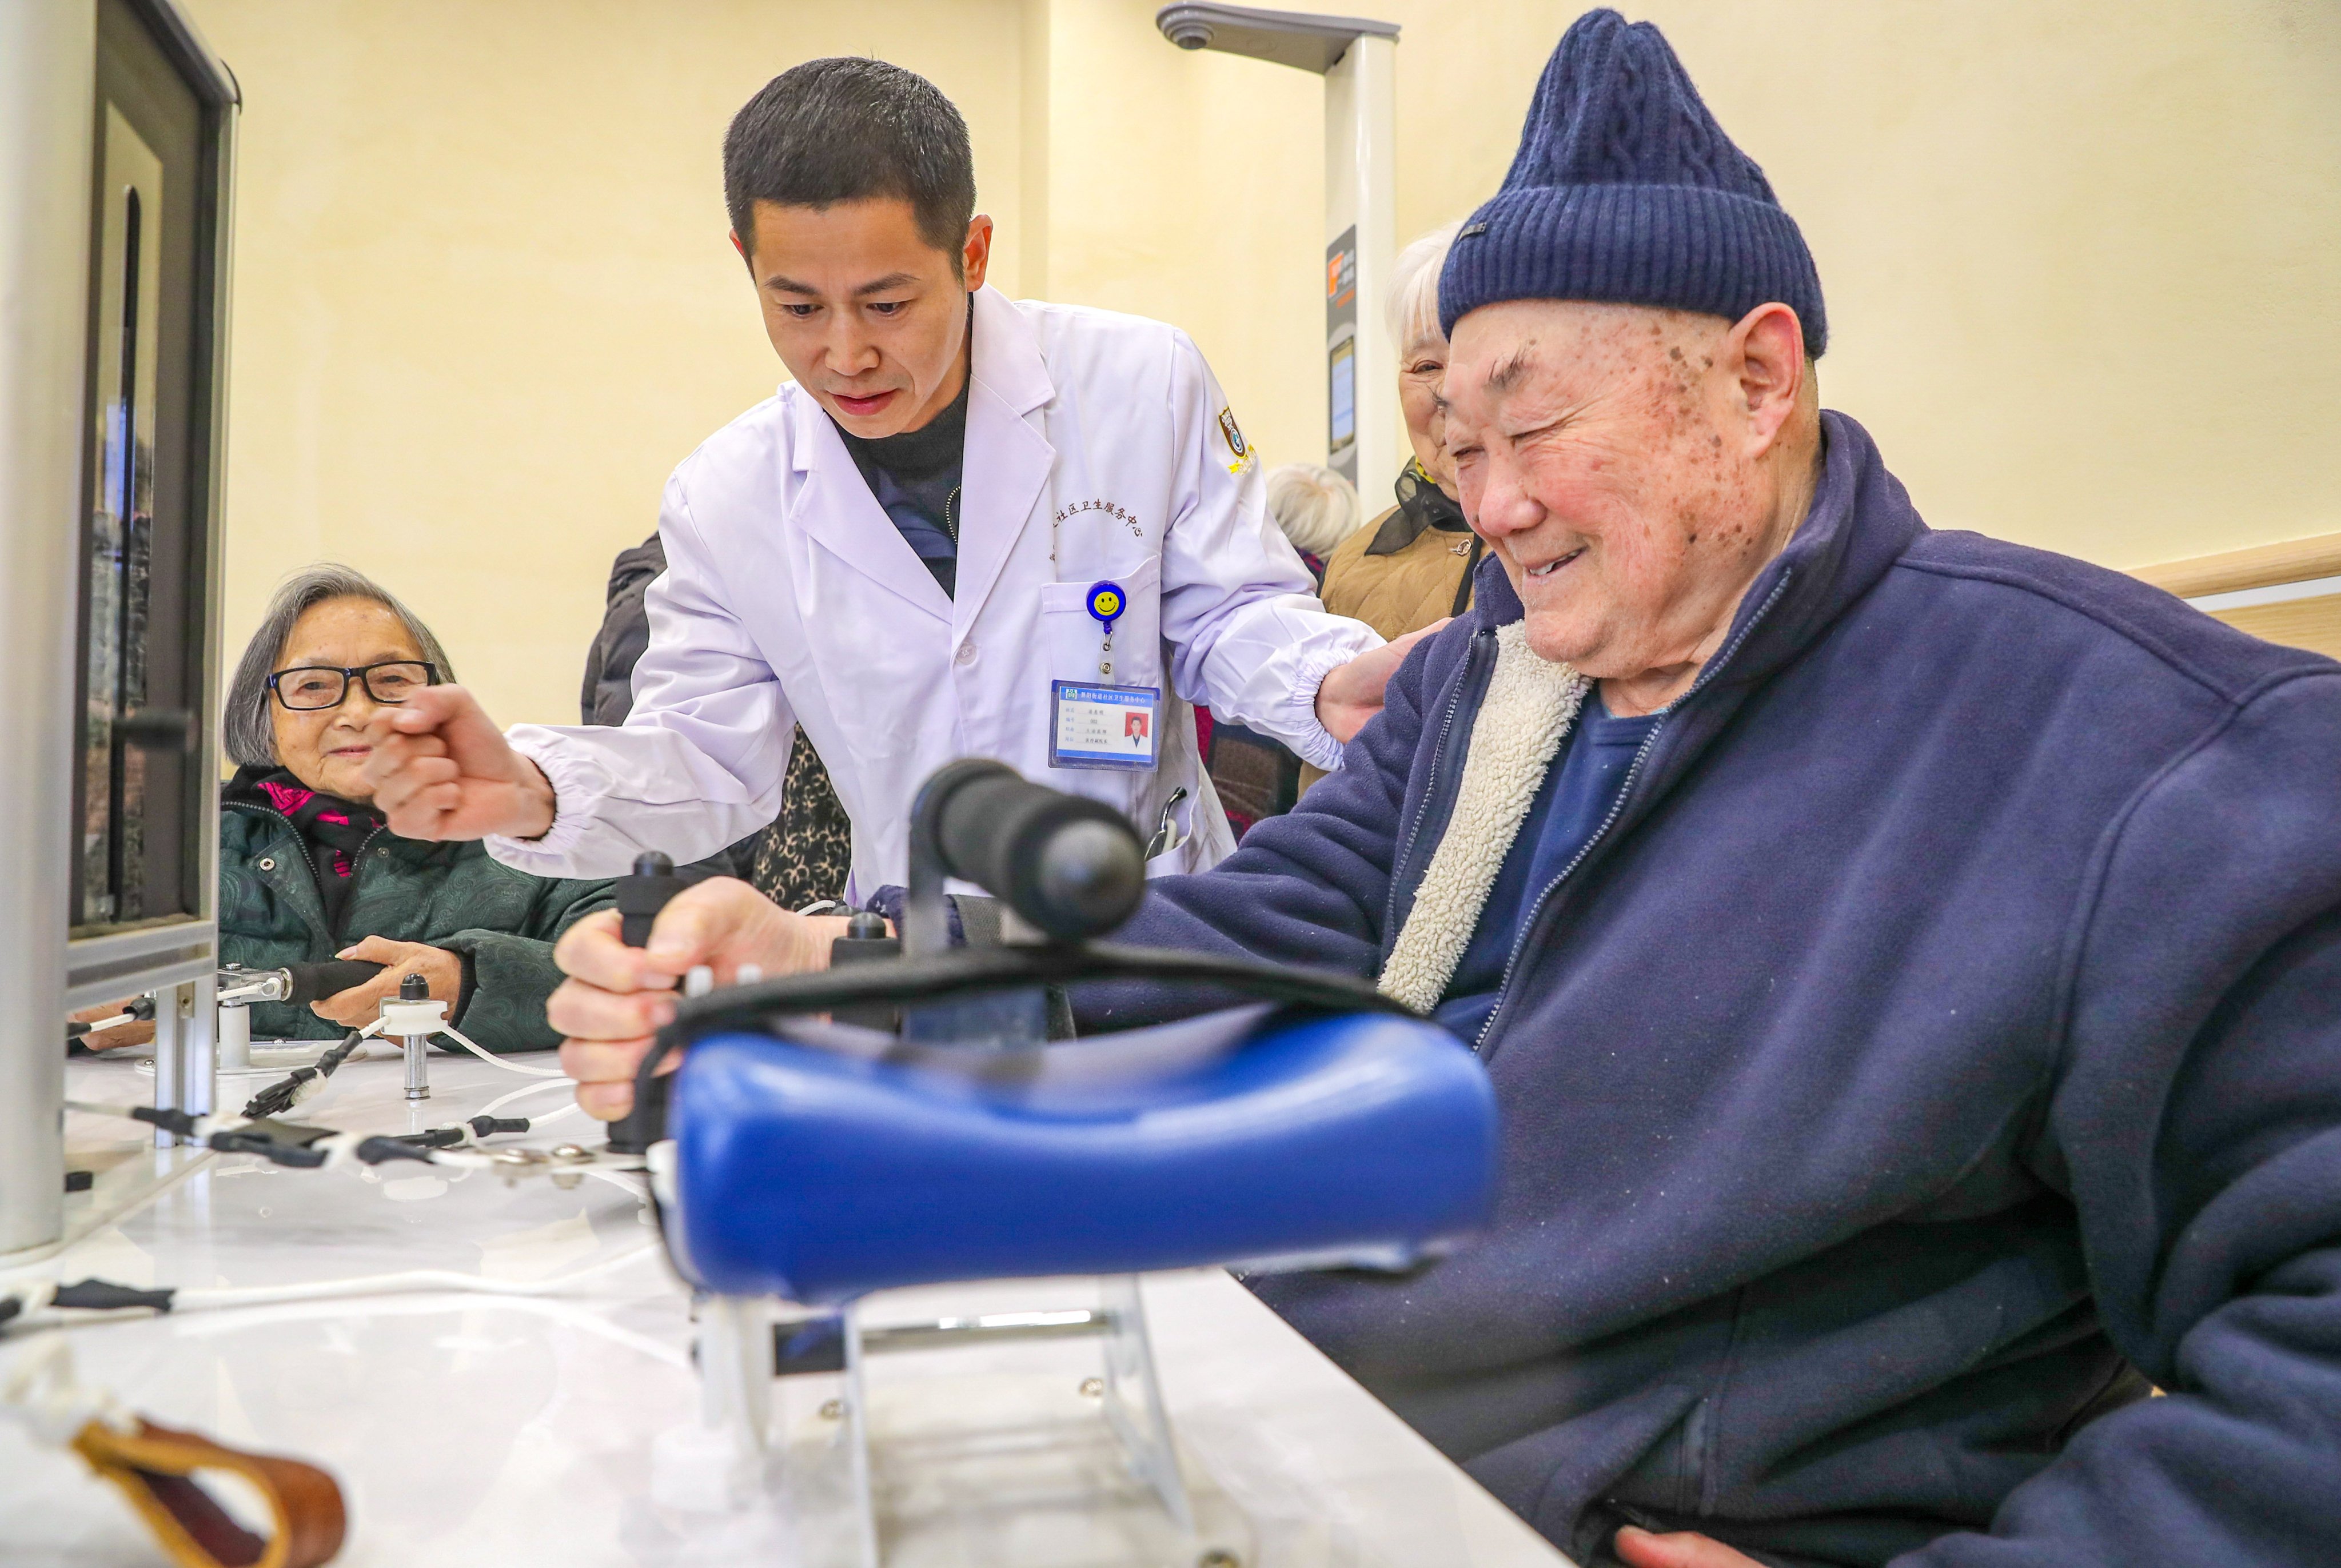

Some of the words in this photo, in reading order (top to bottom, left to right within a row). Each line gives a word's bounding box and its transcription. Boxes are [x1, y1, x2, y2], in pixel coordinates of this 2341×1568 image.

[1053, 498, 1143, 537] 社区卫生服务中心
